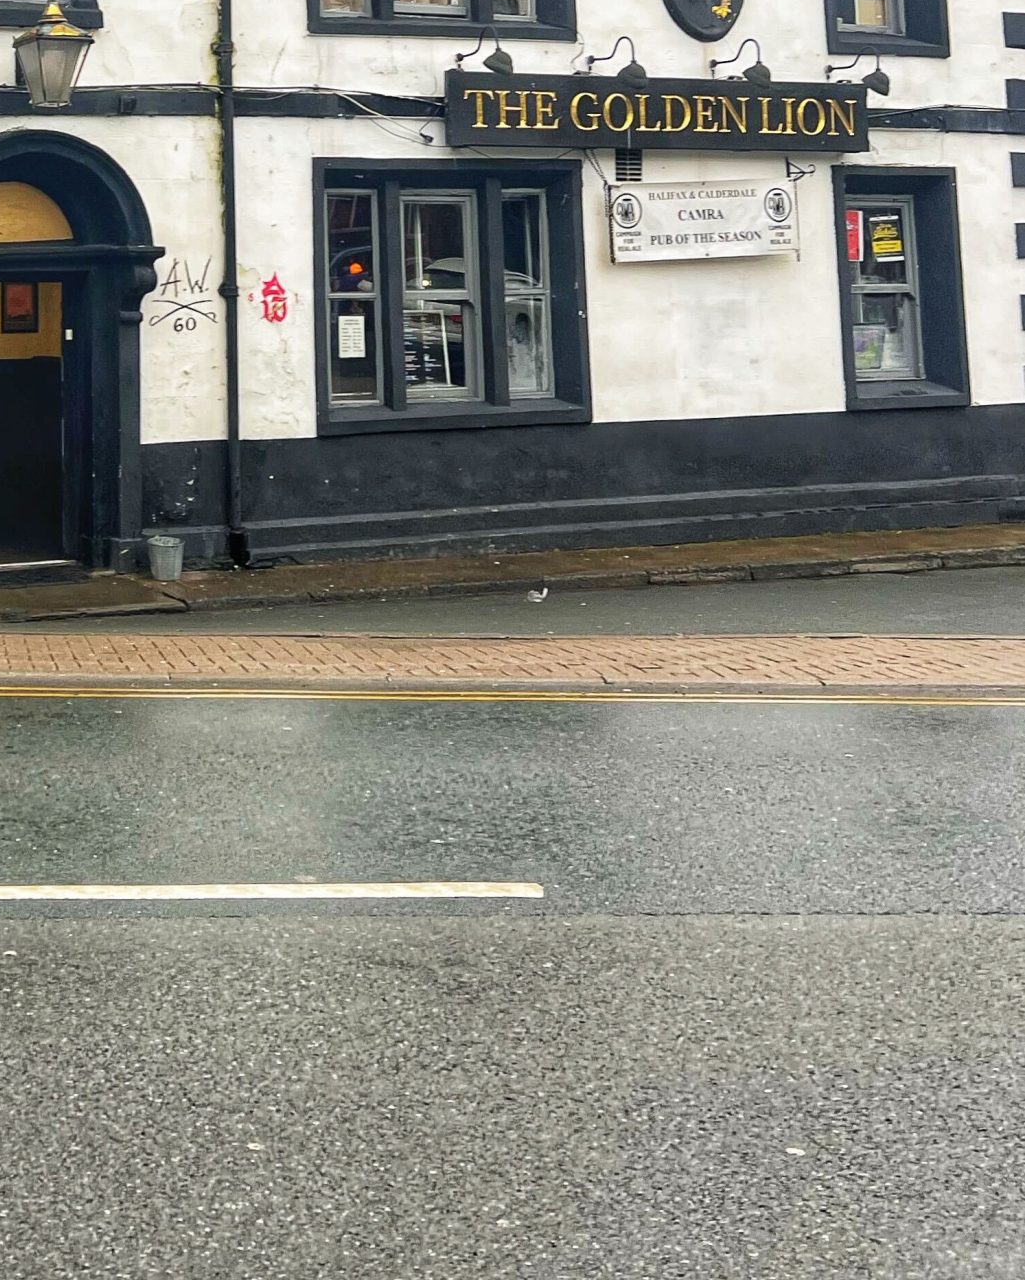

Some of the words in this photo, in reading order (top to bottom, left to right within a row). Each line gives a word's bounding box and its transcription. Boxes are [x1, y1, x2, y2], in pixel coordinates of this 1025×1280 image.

[463, 89, 560, 131] THE
[570, 92, 748, 134] GOLDEN
[757, 97, 858, 136] LION
[648, 191, 687, 201] HALIFAX
[689, 191, 696, 199] &
[698, 188, 757, 199] CALDERDALE
[678, 208, 724, 221] CAMRA
[650, 234, 673, 246] PUB
[675, 233, 691, 244] OF
[693, 232, 717, 243] THE
[718, 230, 762, 242] SEASON
[173, 317, 197, 332] 60
